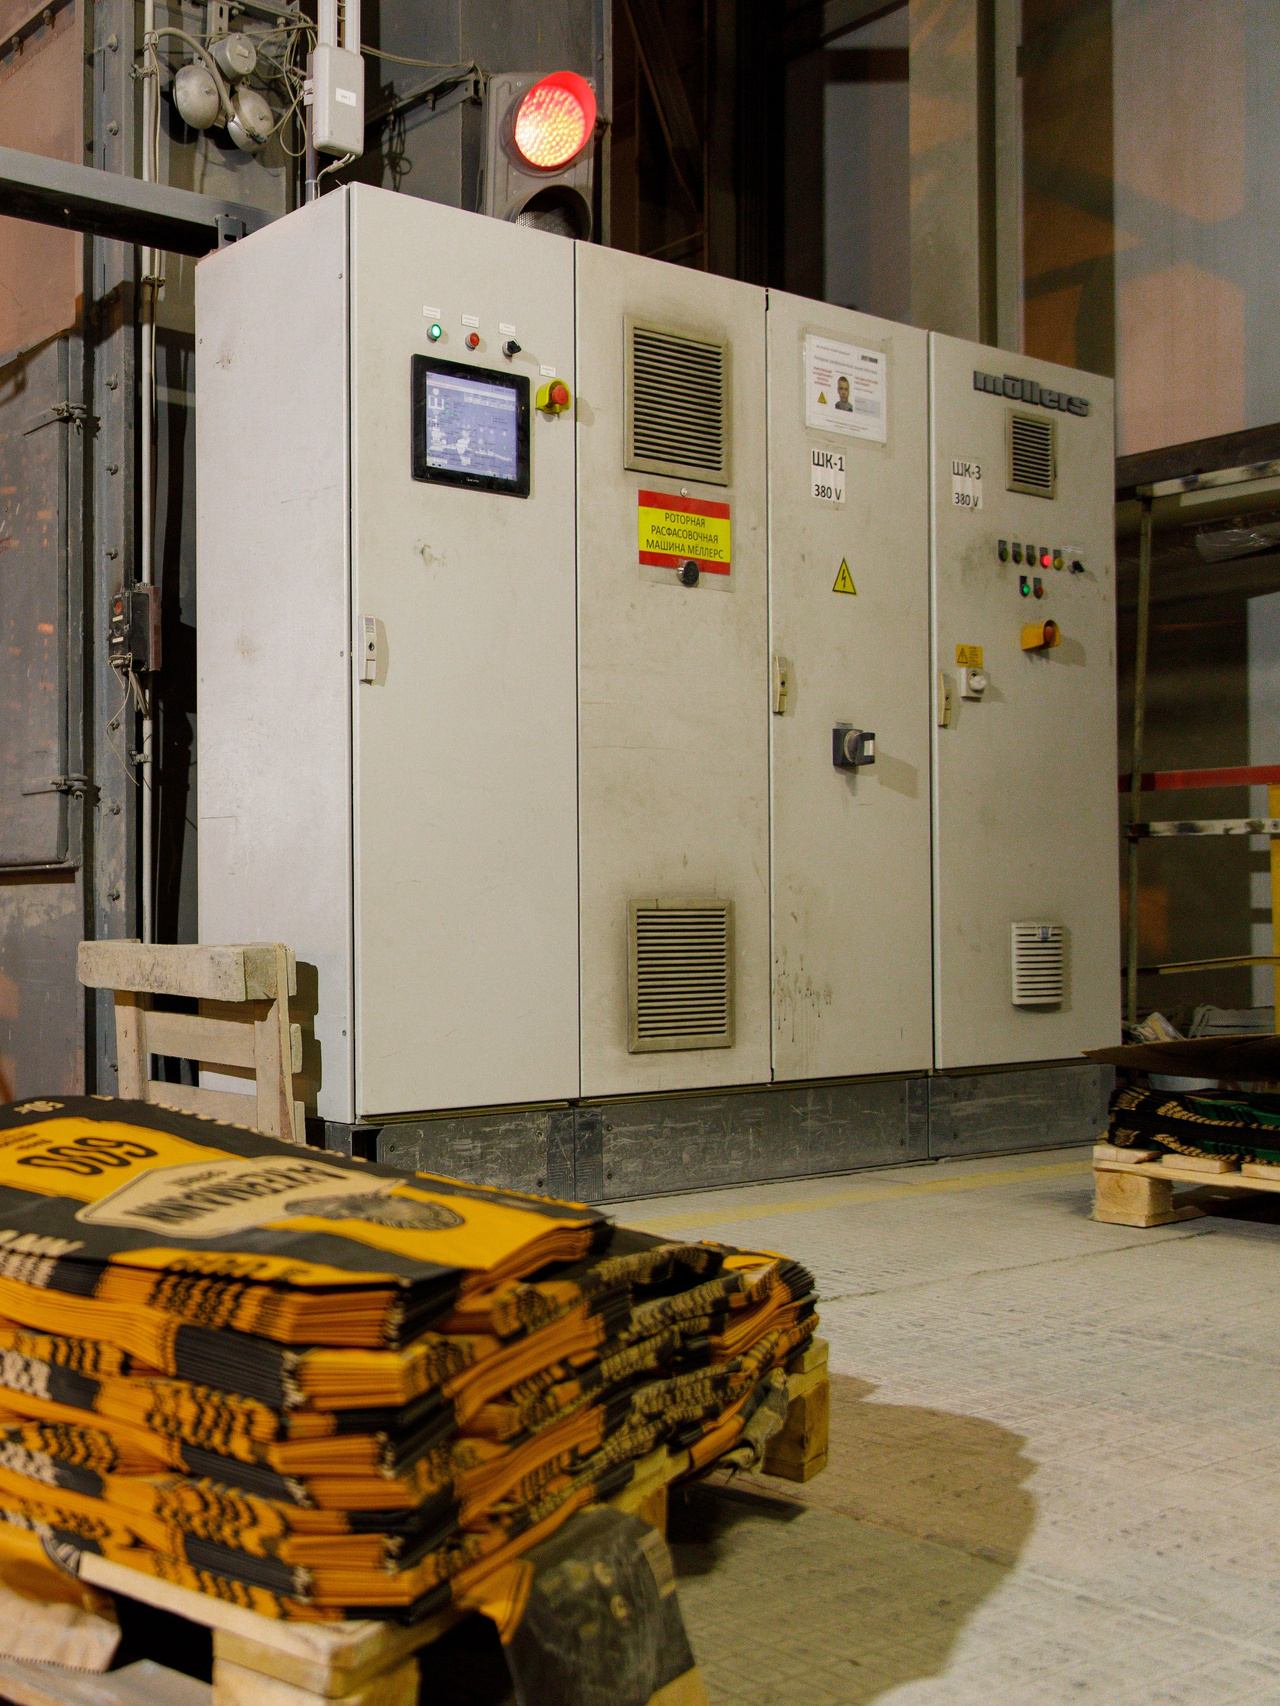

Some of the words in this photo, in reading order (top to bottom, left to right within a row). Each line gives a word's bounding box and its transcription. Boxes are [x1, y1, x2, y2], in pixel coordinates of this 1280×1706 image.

[812, 450, 845, 472] ШК-1
[952, 460, 982, 480] ШК-3
[814, 484, 833, 499] 380
[834, 488, 842, 501] V
[954, 492, 971, 507] 380
[972, 495, 979, 507] V
[664, 512, 706, 528] РОТОРНАЯ
[651, 525, 719, 544] РАСФАСОВОЧНАЯ
[646, 538, 686, 554] МАШИНА
[16, 1136, 160, 1177] 600
